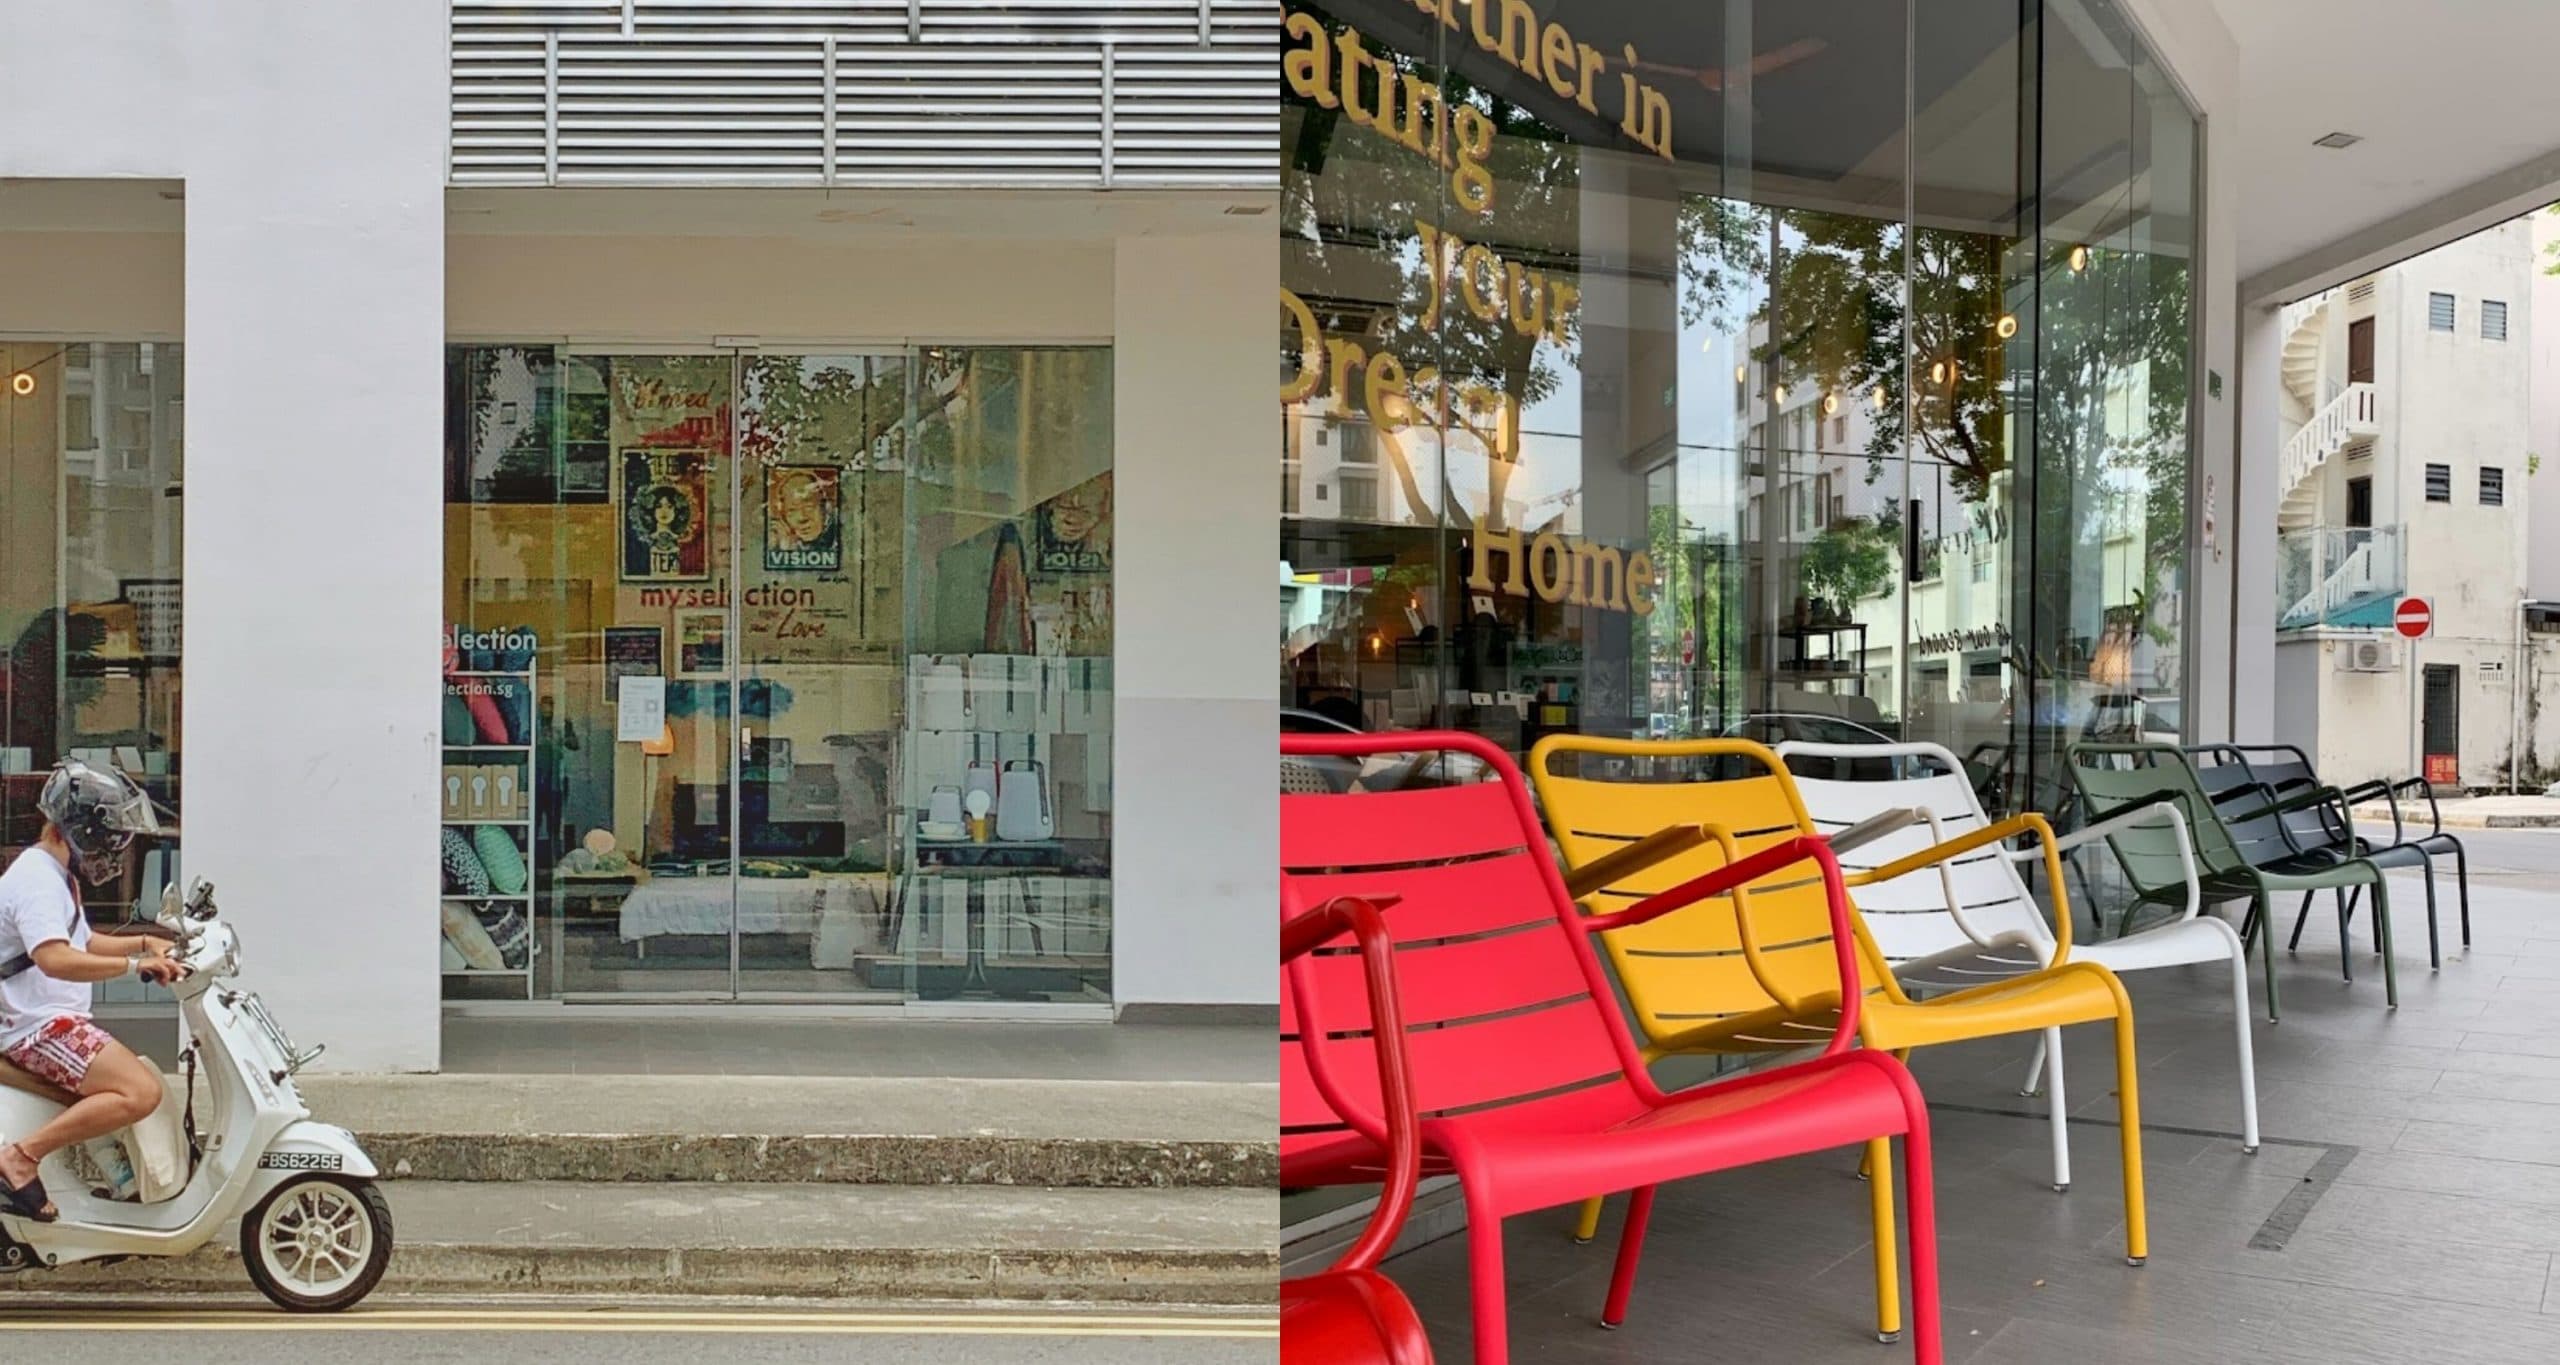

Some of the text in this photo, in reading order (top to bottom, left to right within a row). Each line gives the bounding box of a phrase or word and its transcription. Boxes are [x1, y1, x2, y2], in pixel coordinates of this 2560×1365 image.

[1281, 5, 1497, 212] ating
[1621, 43, 1674, 163] in
[771, 551, 836, 566] VISION
[1466, 489, 1656, 616] Home
[776, 608, 826, 639] Love
[259, 1153, 341, 1170] FBS6225E
